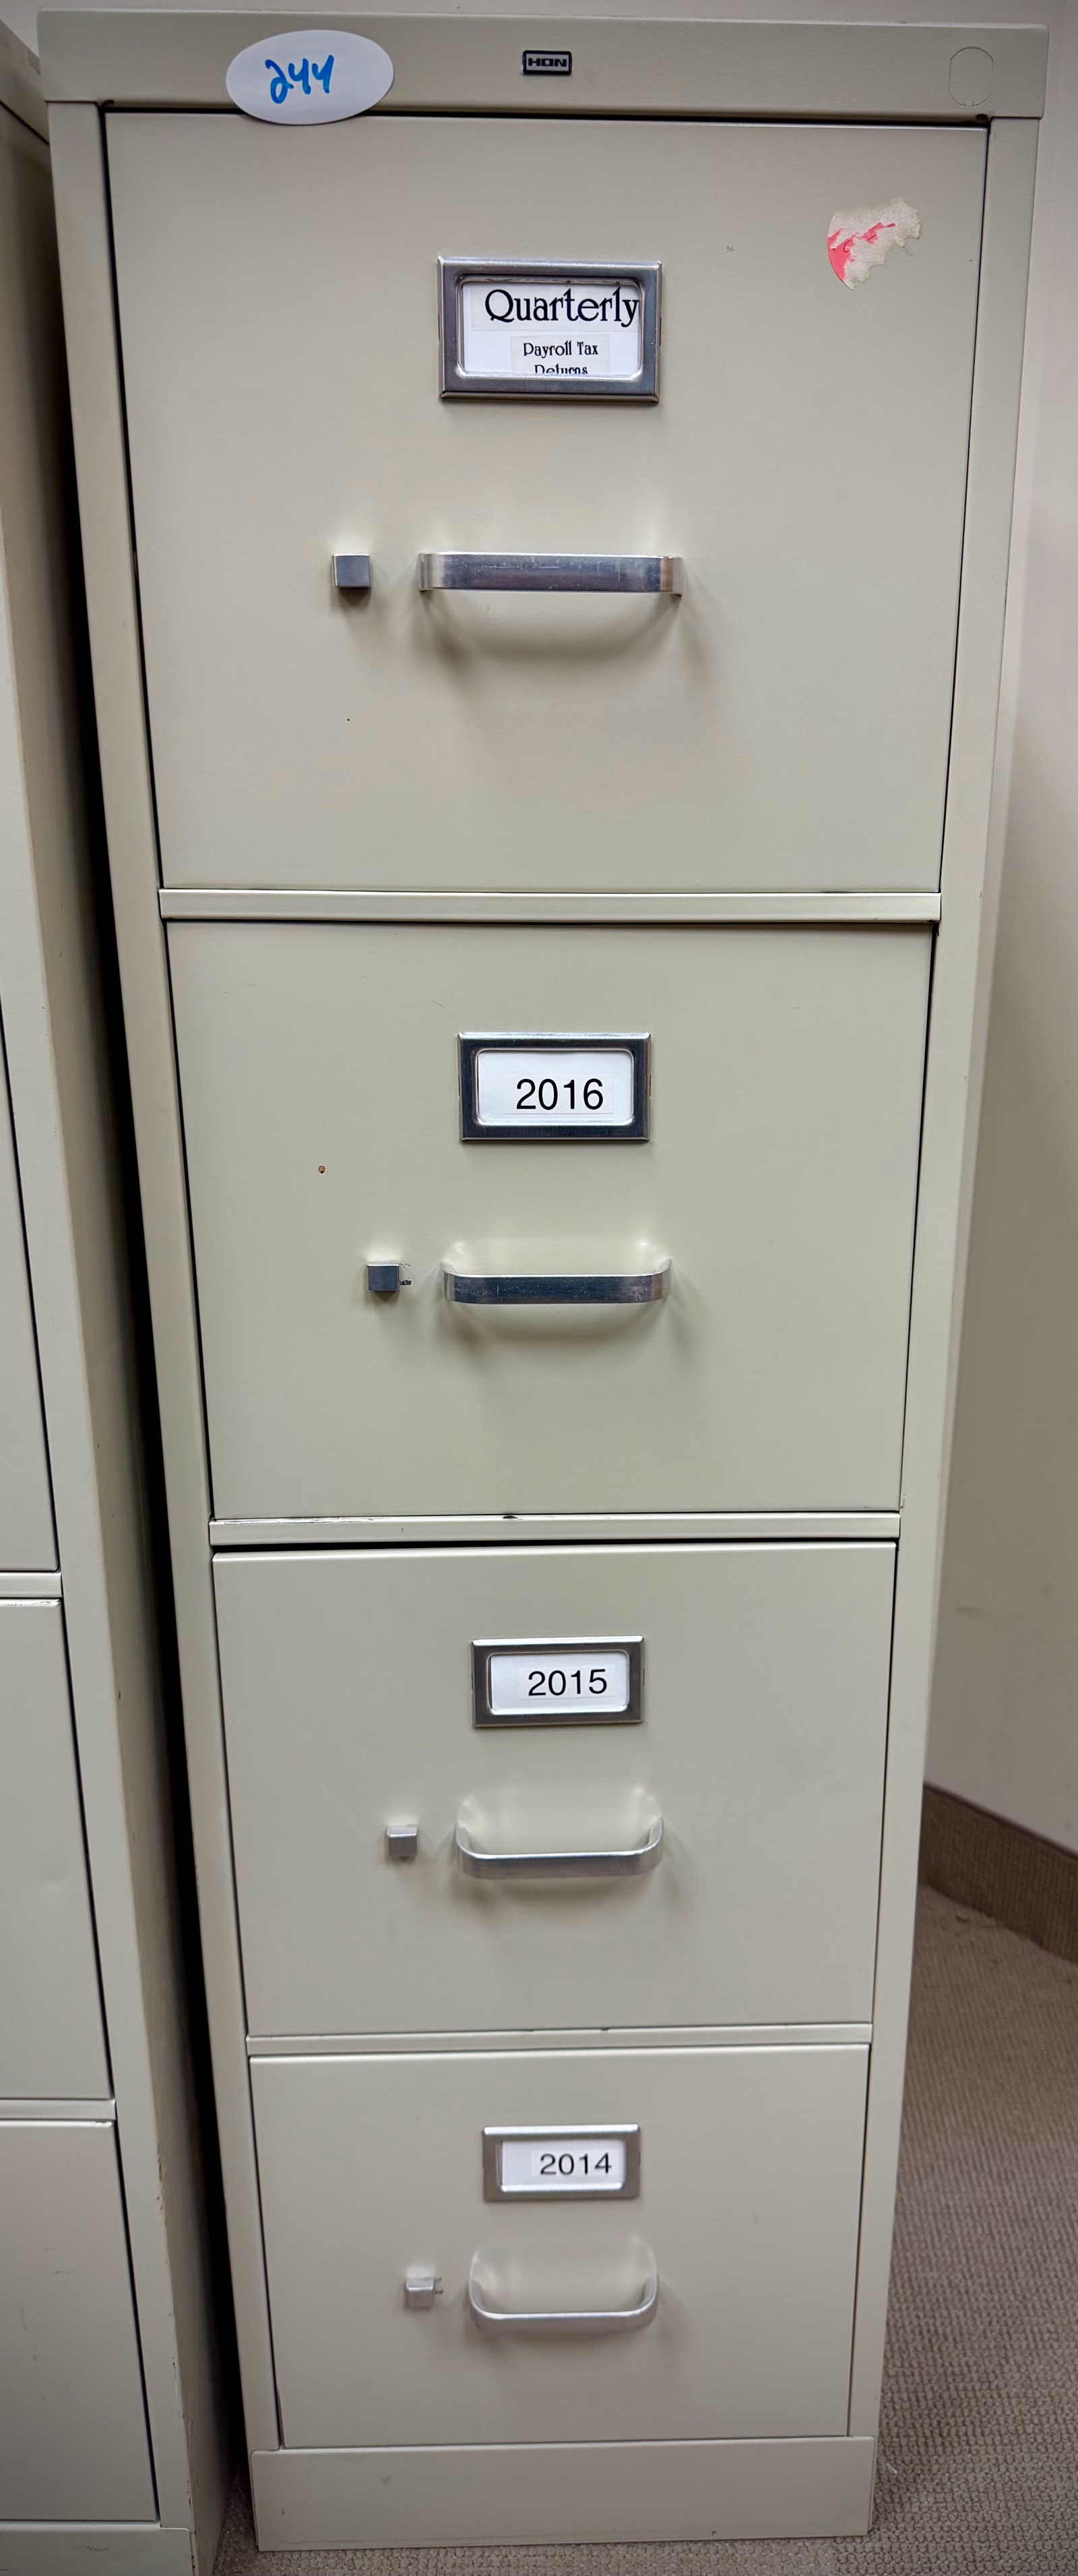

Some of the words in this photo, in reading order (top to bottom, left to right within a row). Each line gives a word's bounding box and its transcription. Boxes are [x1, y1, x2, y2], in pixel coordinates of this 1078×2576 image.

[528, 58, 567, 67] HON
[265, 55, 334, 104] 244
[485, 286, 639, 328] Quarterly
[523, 340, 572, 359] Payroll
[577, 341, 598, 355] Tax
[516, 1078, 604, 1110] 2016
[528, 1669, 607, 1696] 2015
[540, 2152, 612, 2175] 2014
